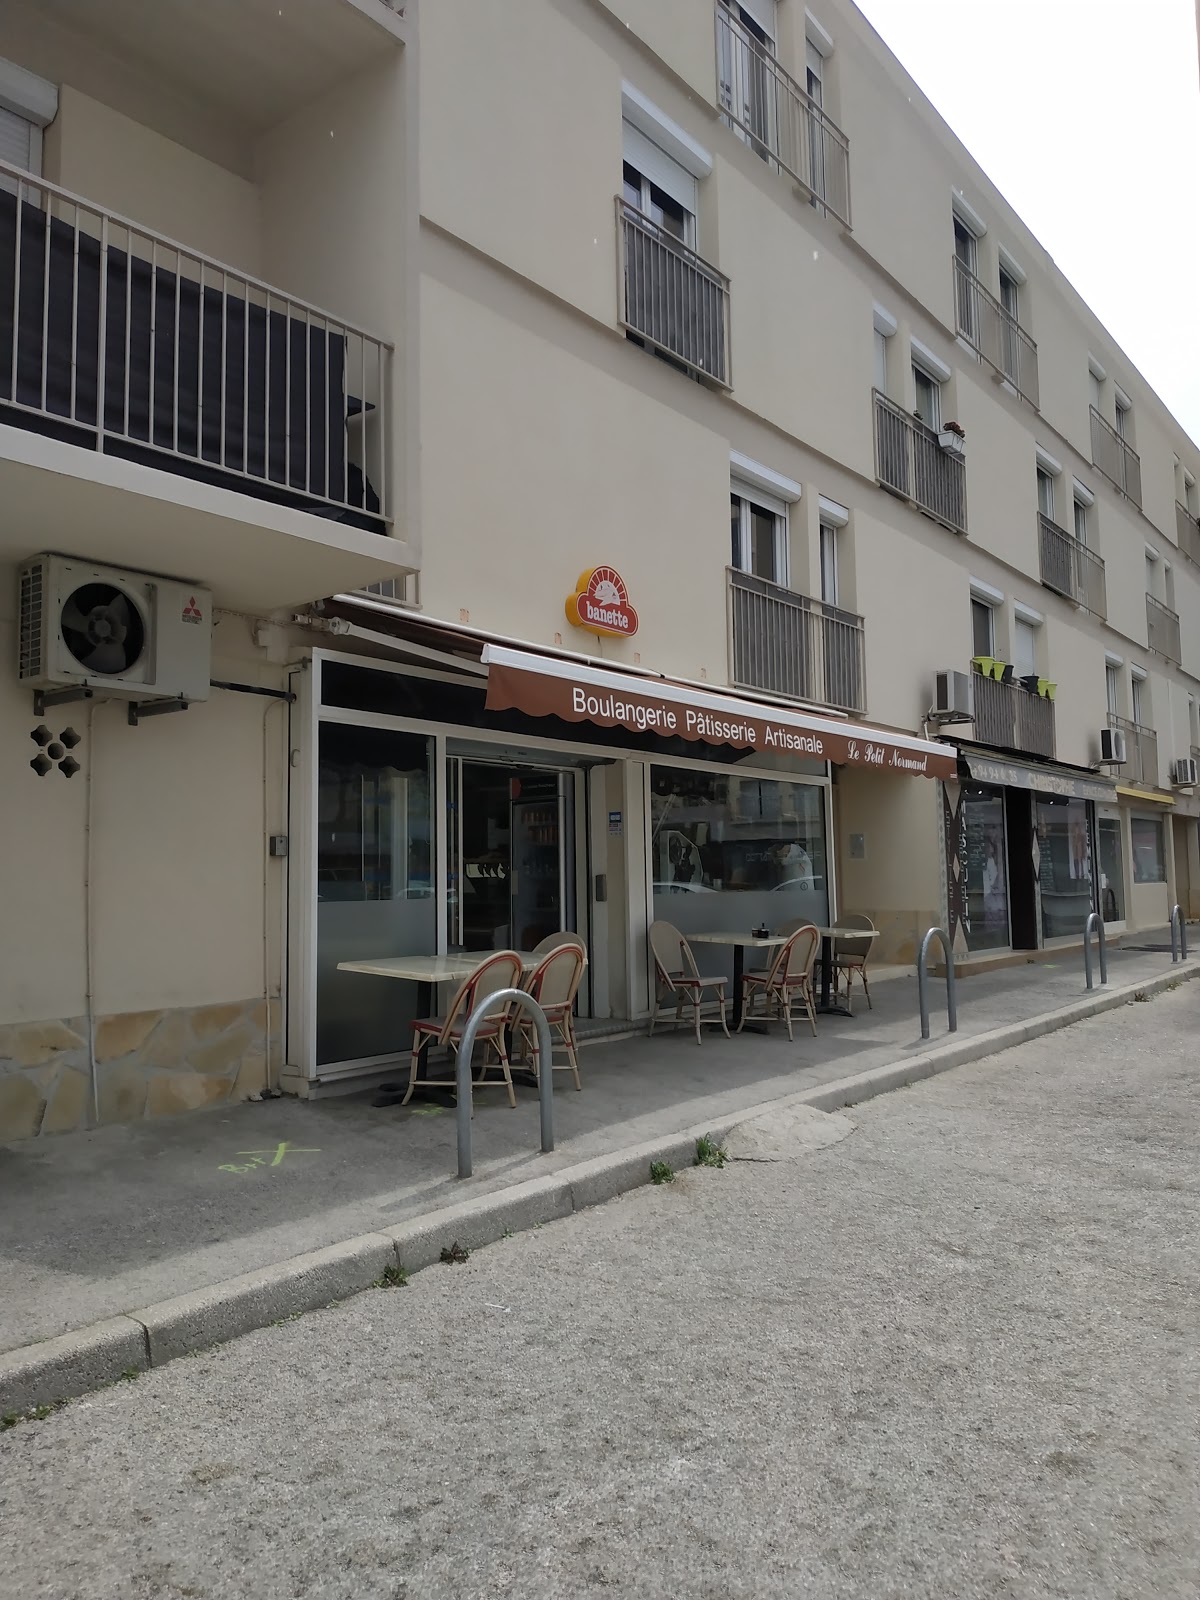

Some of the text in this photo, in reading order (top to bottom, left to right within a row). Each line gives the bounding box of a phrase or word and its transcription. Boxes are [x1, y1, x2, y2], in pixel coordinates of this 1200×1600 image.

[586, 600, 629, 629] banette
[572, 687, 824, 754] Boulangerie Pâtisserie Artisanale
[847, 740, 928, 772] Le Petit Normand
[960, 800, 971, 934] MASCULIN
